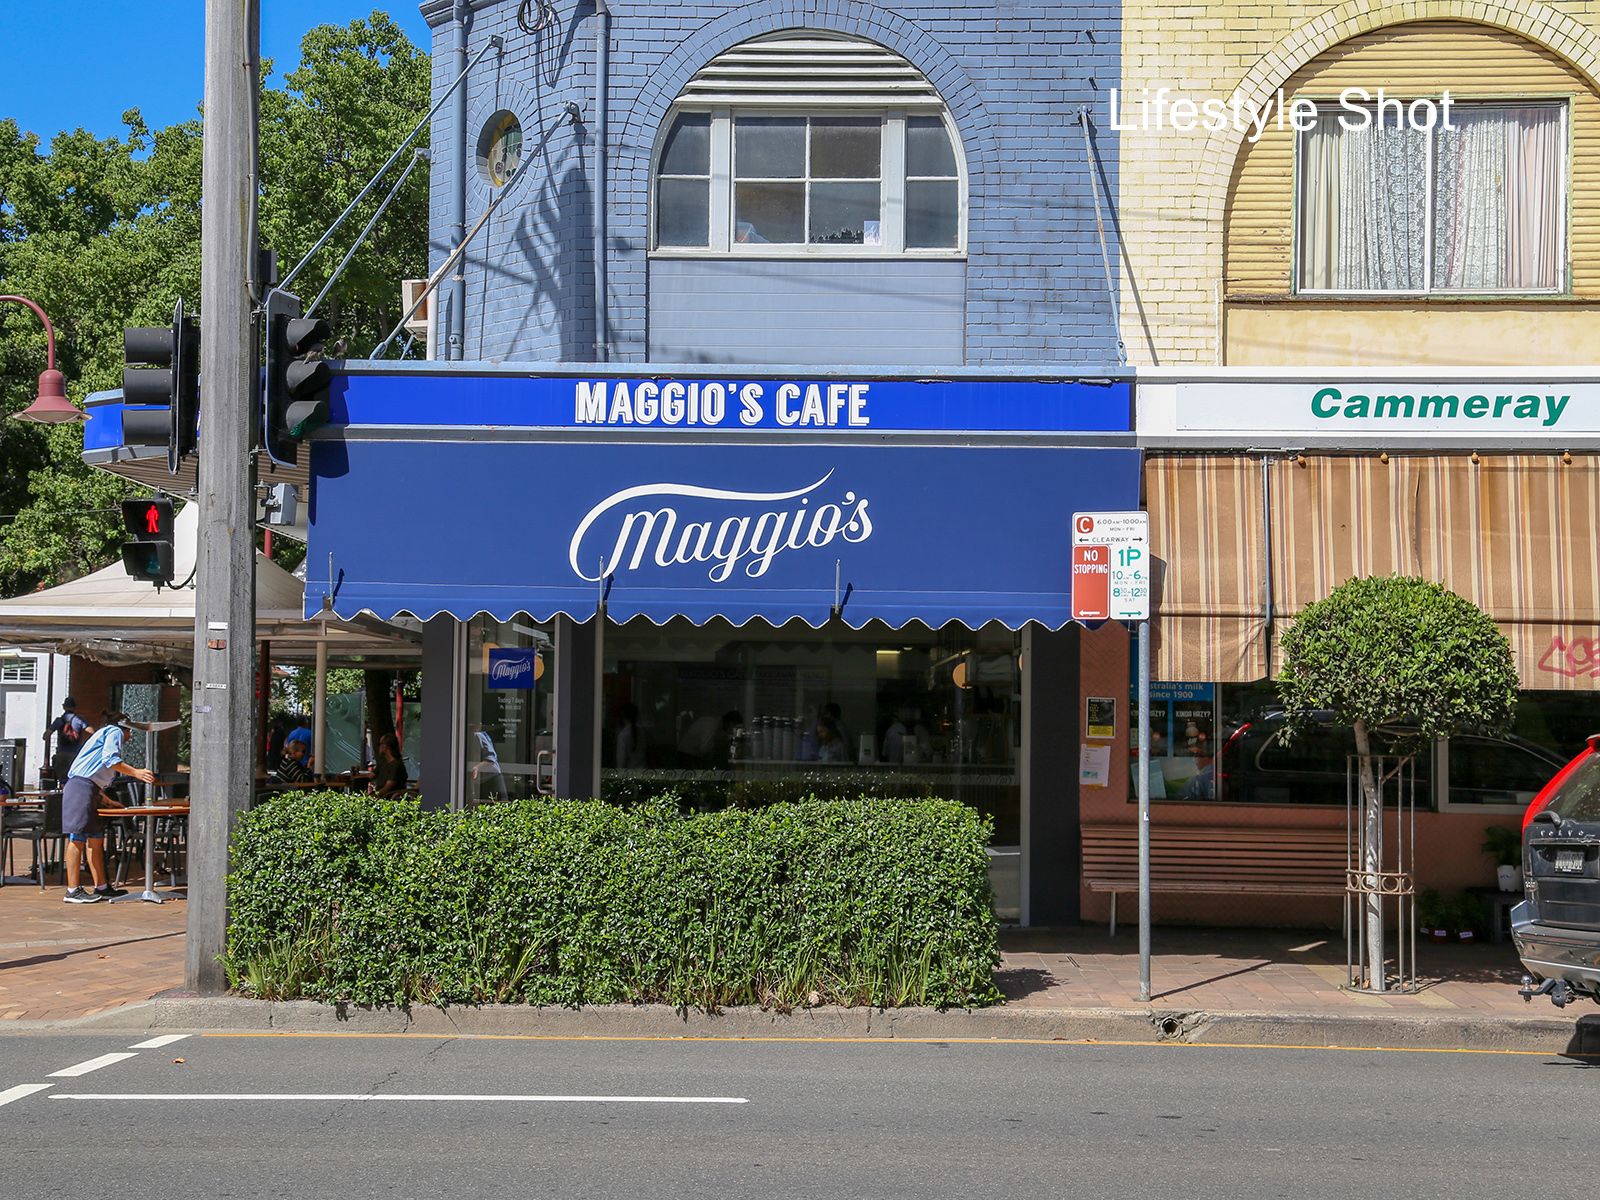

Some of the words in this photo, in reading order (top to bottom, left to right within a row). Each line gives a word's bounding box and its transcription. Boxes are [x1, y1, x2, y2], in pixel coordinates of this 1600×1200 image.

[574, 381, 764, 426] MAGGIO'S
[775, 383, 871, 428] CAFE
[1310, 387, 1571, 427] Cammeray
[569, 466, 873, 583] Maggio's
[1079, 517, 1091, 533] C
[1083, 549, 1099, 562] NO
[1118, 548, 1142, 567] 1P
[1074, 563, 1108, 575] STOPPING
[492, 656, 531, 681] Maggio's
[1149, 682, 1183, 690] stralia's
[1184, 682, 1204, 690] milk
[1149, 690, 1171, 698] since
[1173, 691, 1193, 699] 1900
